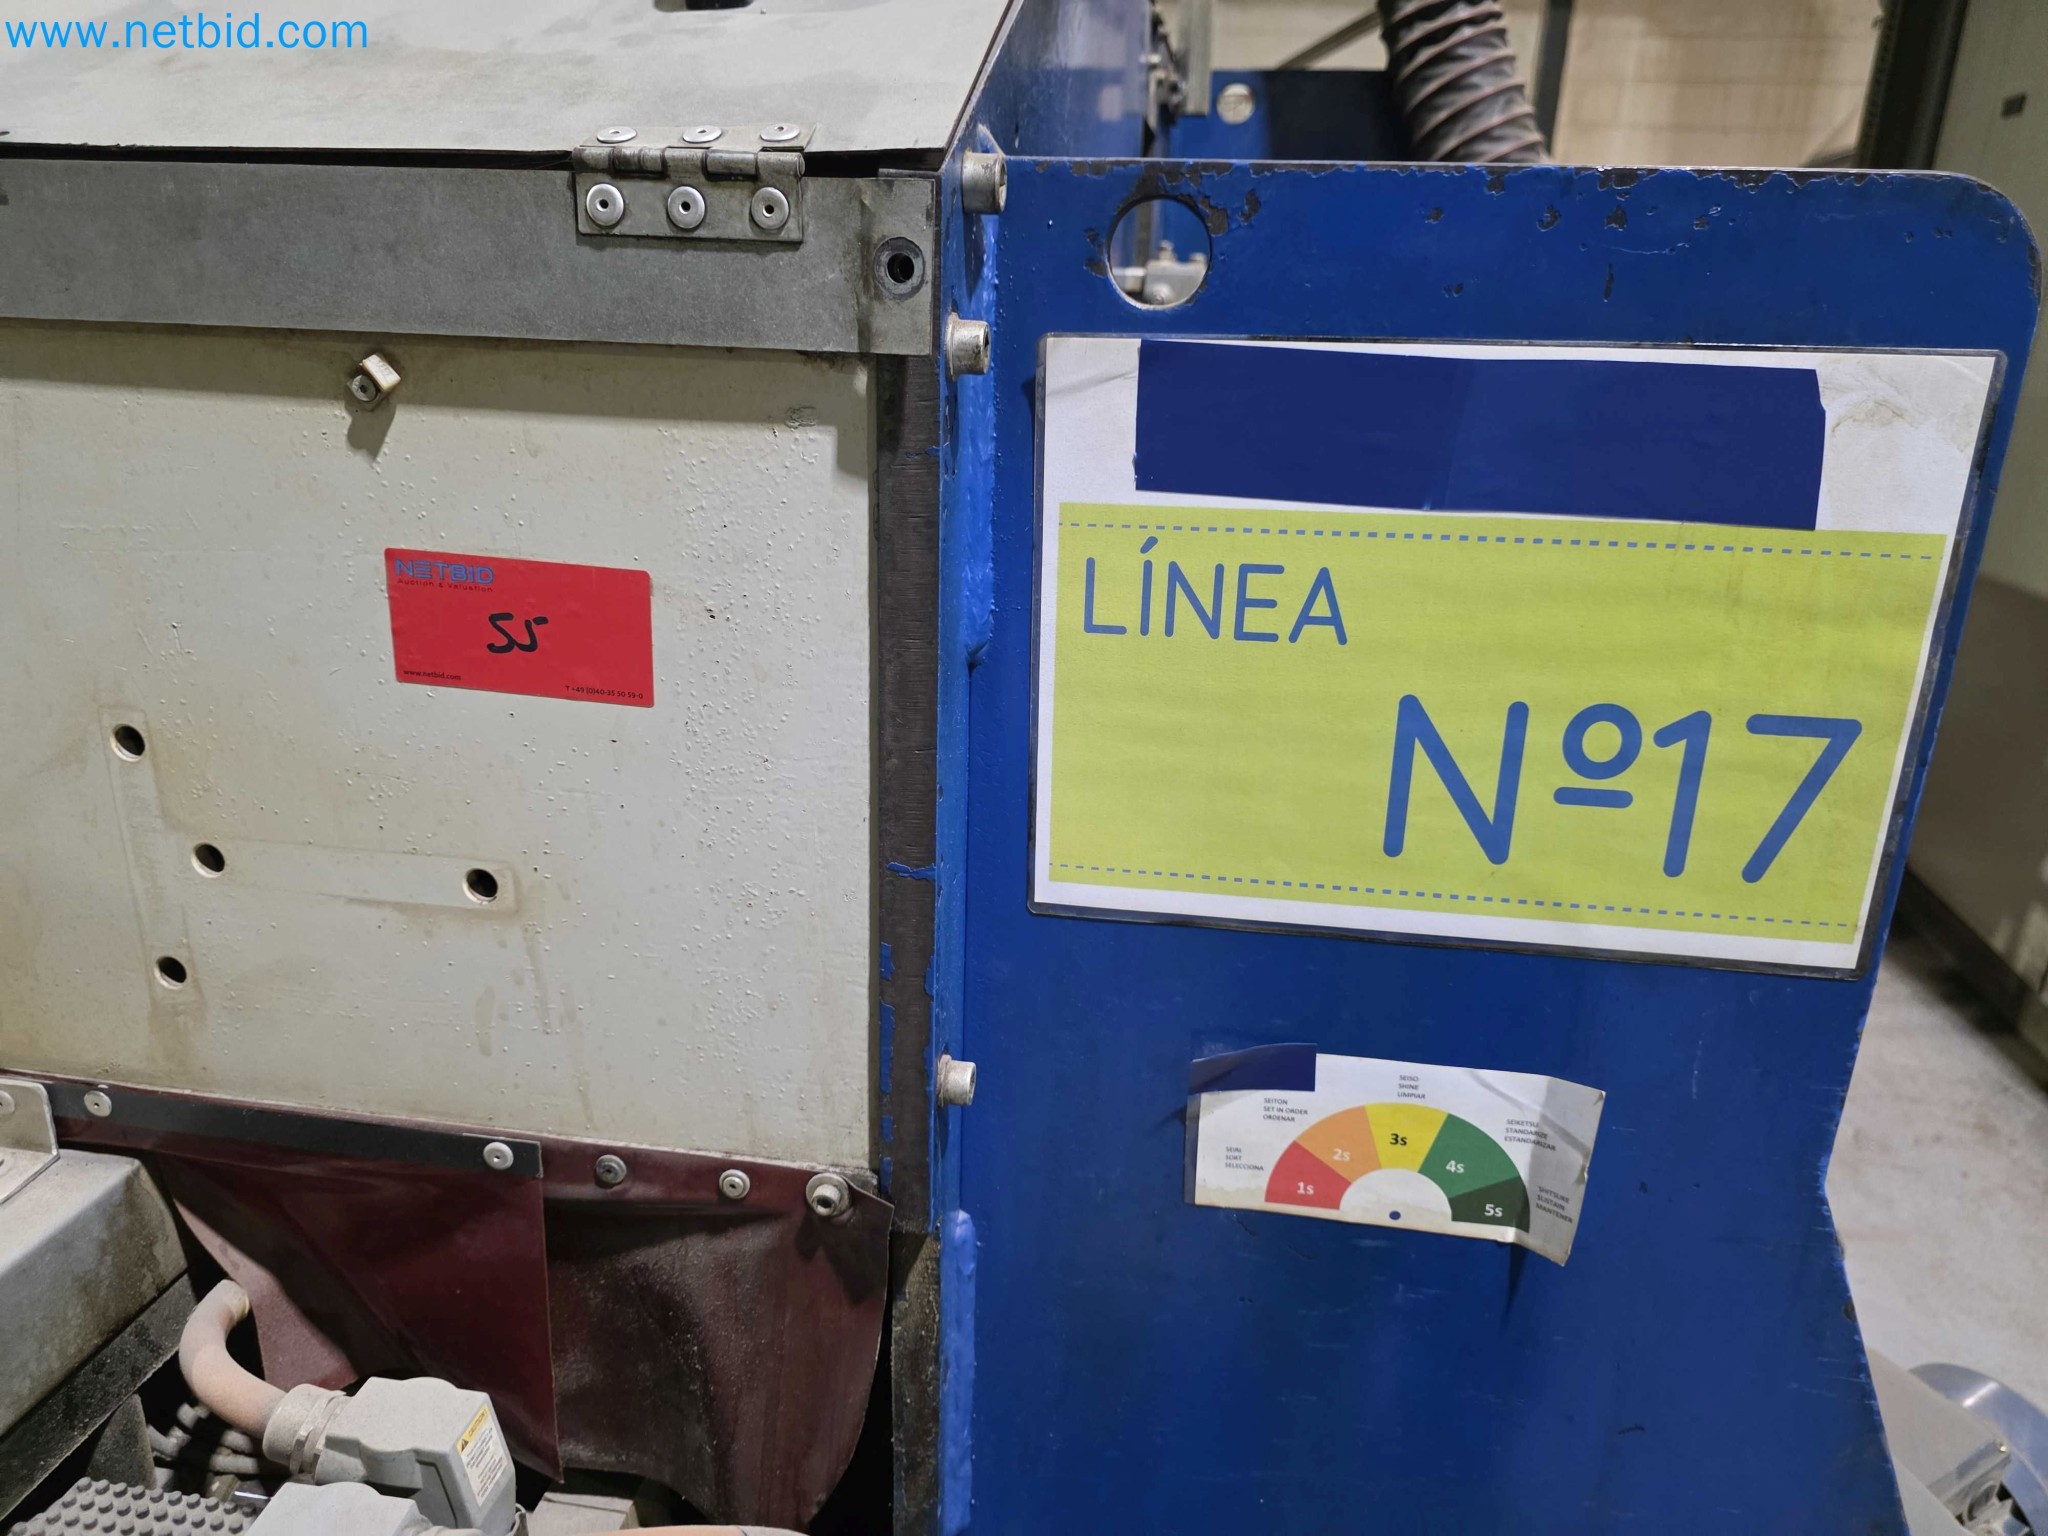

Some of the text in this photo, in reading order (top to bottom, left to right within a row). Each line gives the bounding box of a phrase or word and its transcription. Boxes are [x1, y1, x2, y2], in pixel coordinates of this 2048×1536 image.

[395, 559, 494, 585] NETBID
[397, 578, 434, 588] Auction
[447, 583, 493, 593] Valuation
[1084, 537, 1348, 646] LÍNEA
[403, 670, 462, 681] www.netbid.com
[572, 686, 585, 694] +49
[586, 687, 615, 697] (0)40-35
[627, 691, 644, 700] 59-0
[1398, 1083, 1419, 1091] SHINE
[1263, 1097, 1288, 1105] SEITON
[1397, 1091, 1426, 1099] LIMPIAR
[1263, 1113, 1296, 1122] ORDENAR
[1285, 1107, 1309, 1115] ORDER
[1506, 1119, 1539, 1128] SEIKETSU
[1389, 1132, 1408, 1147] 3s
[1504, 1136, 1557, 1151] ESTANDARIZAR
[1333, 1148, 1351, 1163] 2s
[1445, 1160, 1465, 1174] 4s
[1296, 1181, 1314, 1196] 1s
[1485, 1203, 1504, 1218] 5s
[1535, 1203, 1573, 1224] MANTENER
